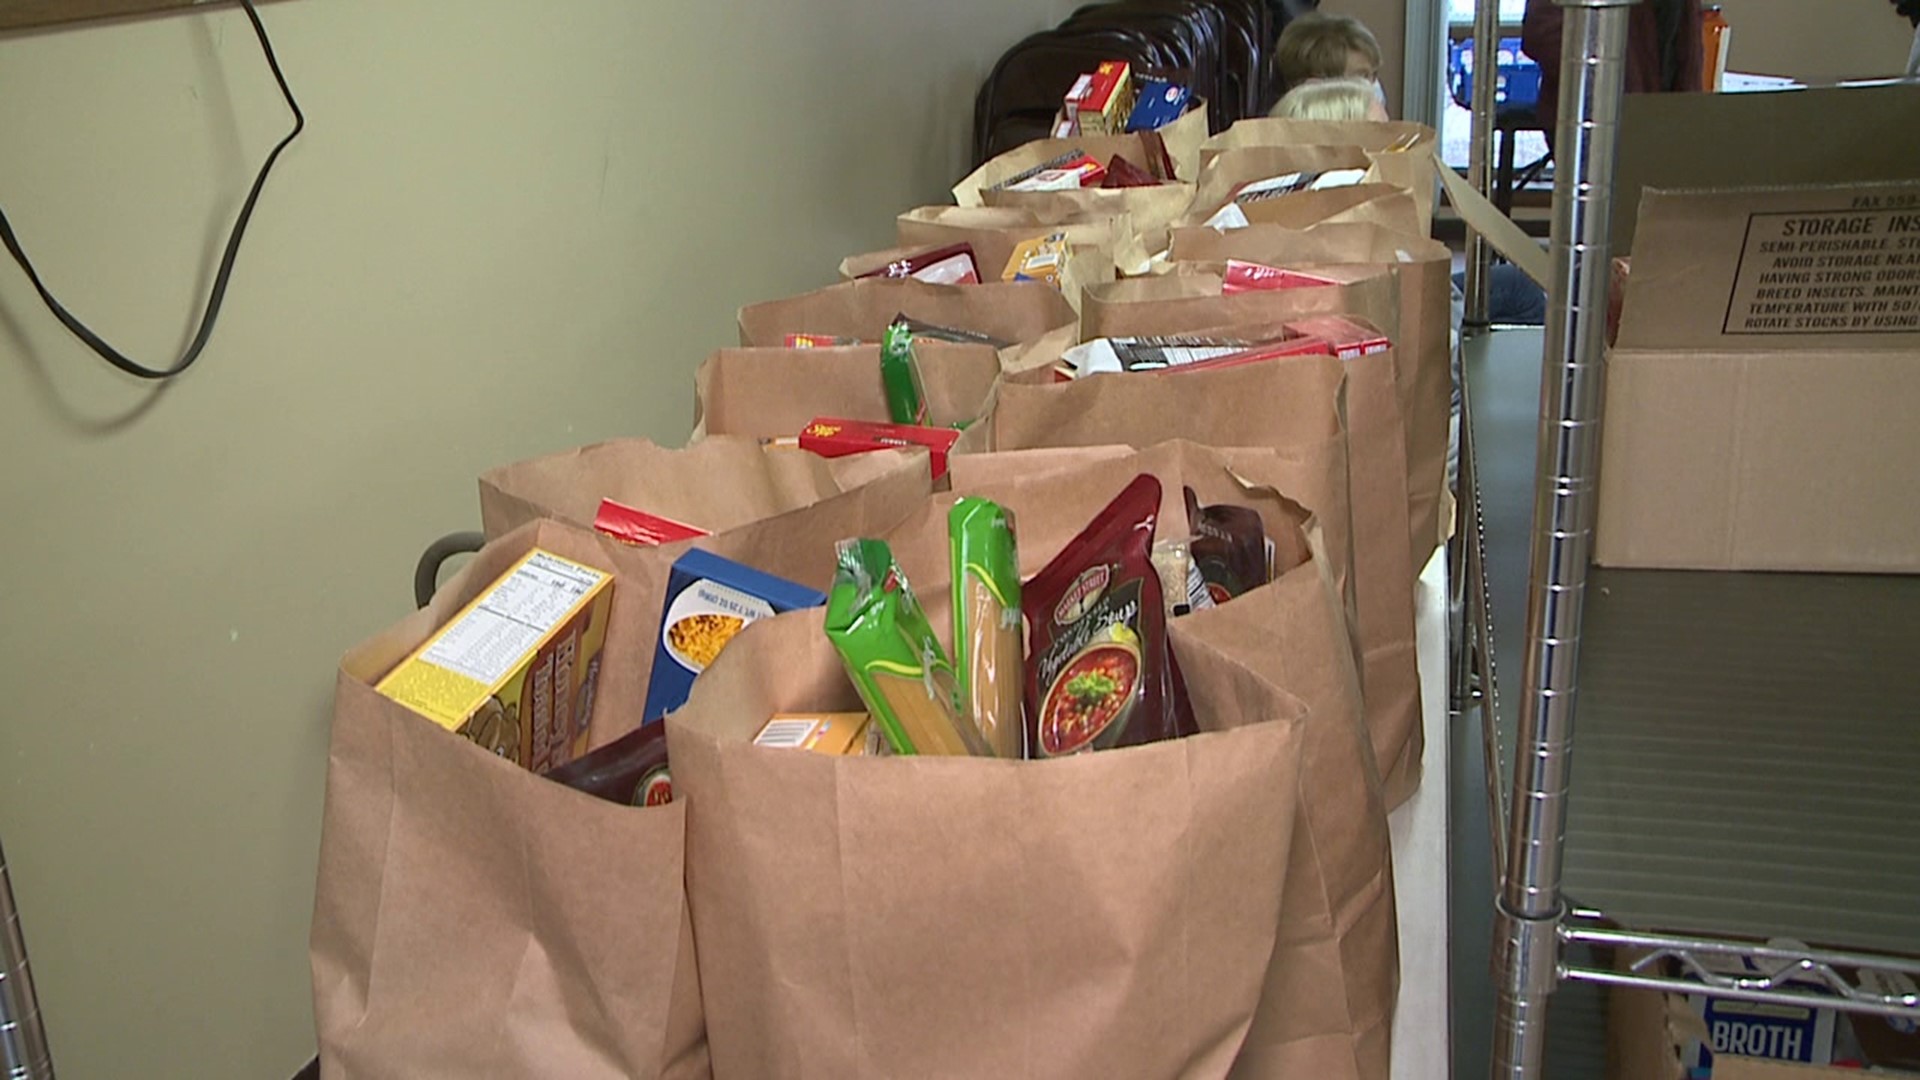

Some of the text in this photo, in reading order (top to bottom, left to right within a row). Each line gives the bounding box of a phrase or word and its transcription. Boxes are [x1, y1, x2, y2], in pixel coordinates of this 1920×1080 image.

[1782, 214, 1920, 236] STORAGE INS
[1773, 257, 1814, 269] AVOID
[1817, 255, 1880, 268] STORAGE
[1759, 272, 1811, 284] HAVING
[1814, 271, 1873, 283] STRONG
[1756, 288, 1802, 299] BREED
[1873, 285, 1920, 297] MAINT
[1750, 300, 1920, 315] TEMPERATURE WITH 50/
[1745, 315, 1918, 328] ROTATE STOCKS BY USING
[1713, 1020, 1803, 1060] BROTH
